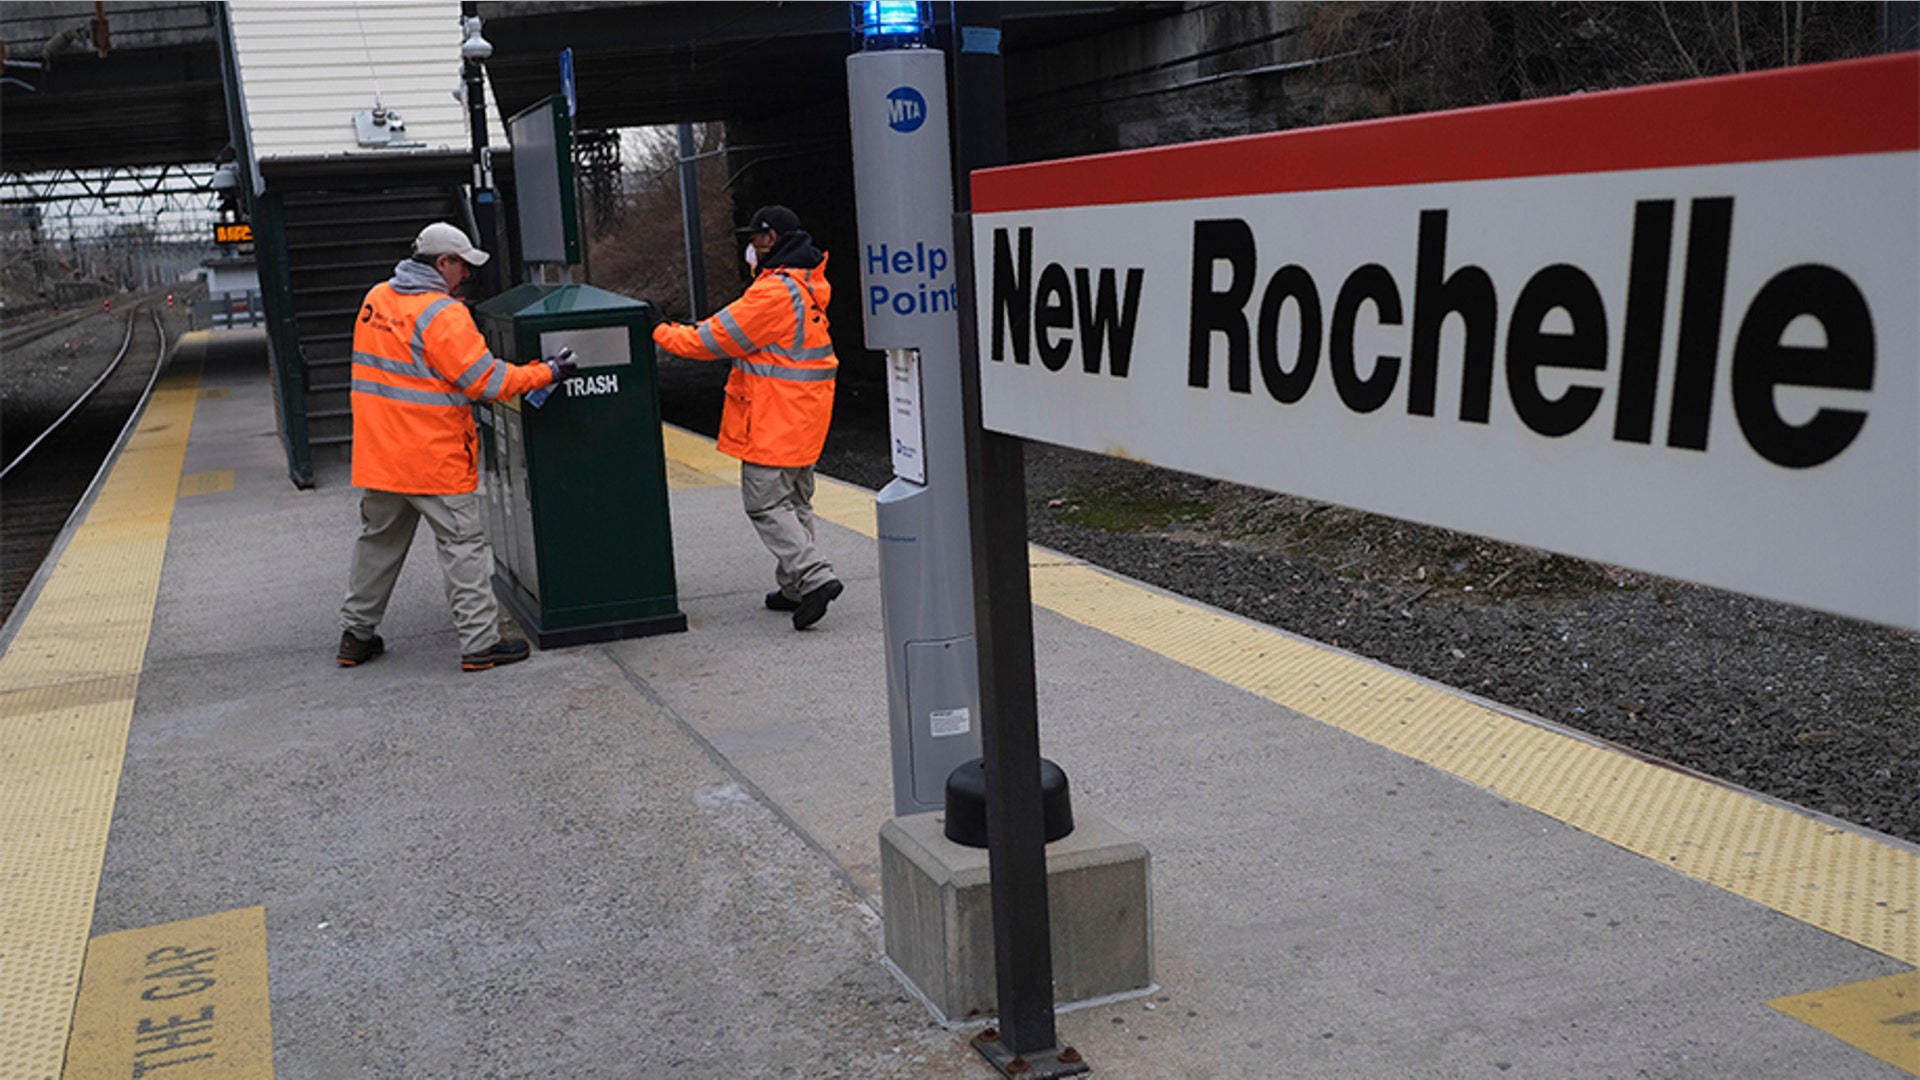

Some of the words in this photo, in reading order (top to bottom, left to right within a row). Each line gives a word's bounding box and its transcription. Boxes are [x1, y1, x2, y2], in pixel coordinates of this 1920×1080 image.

[886, 96, 922, 126] MTA
[866, 241, 948, 280] Help
[869, 282, 958, 316] Point
[991, 226, 1145, 378] New
[1187, 196, 1878, 470] Rochelle
[563, 374, 619, 397] TRASH
[141, 946, 219, 1001] GAP
[132, 1005, 216, 1080] THE
